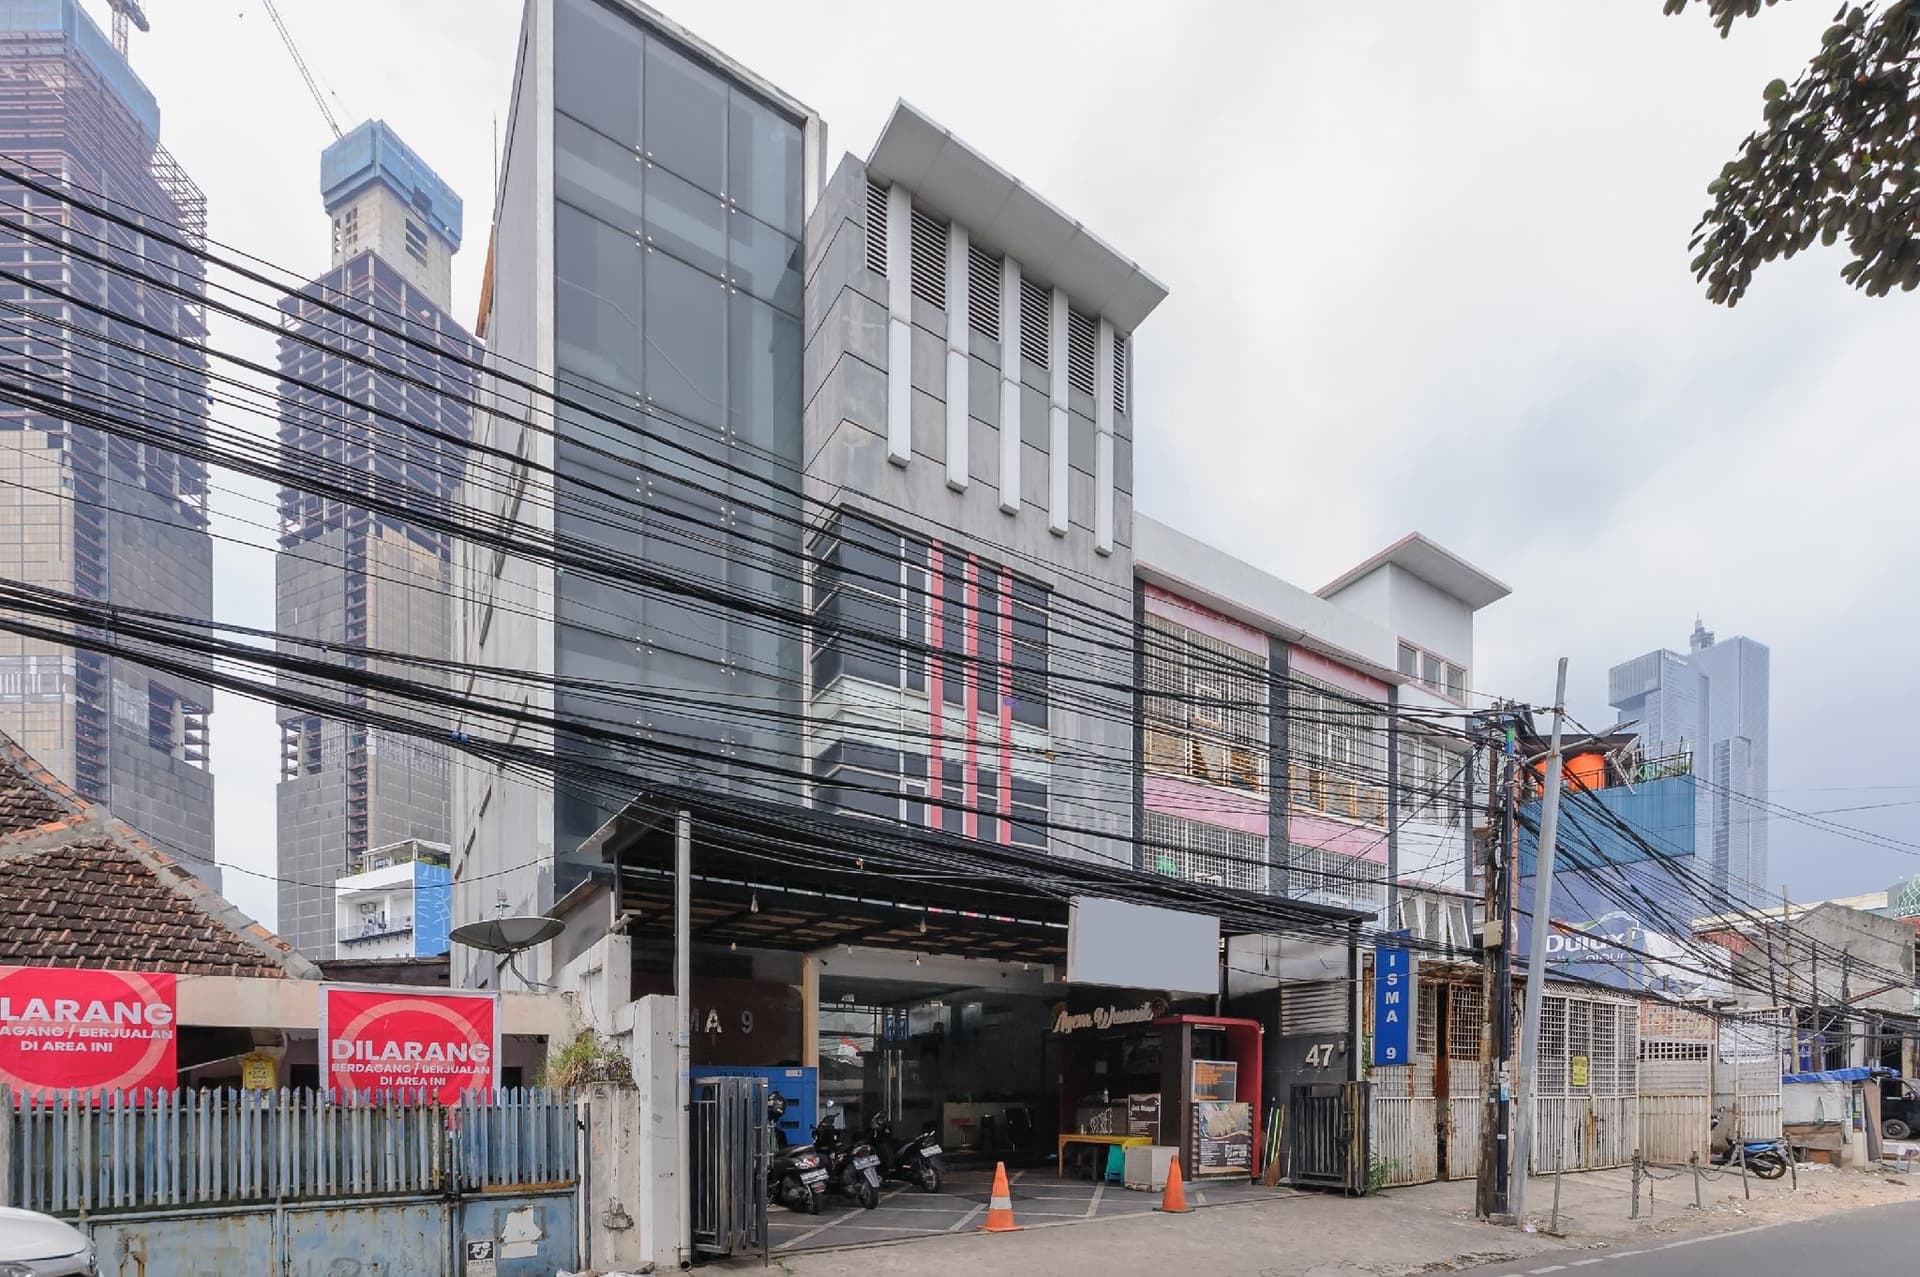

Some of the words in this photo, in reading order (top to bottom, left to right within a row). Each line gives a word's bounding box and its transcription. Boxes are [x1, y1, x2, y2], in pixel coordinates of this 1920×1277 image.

[1545, 933, 1625, 953] Dulux
[1385, 954, 1399, 1022] ISMA
[0, 997, 173, 1025] LARANG
[0, 1026, 64, 1037] AGANG
[67, 1025, 75, 1039] /
[79, 1028, 173, 1039] BERJUALAN
[741, 1010, 753, 1034] 9
[20, 1041, 38, 1051] DI
[42, 1041, 87, 1052] AREA
[91, 1042, 113, 1052] INI
[332, 1039, 490, 1062] DILARANG
[1305, 1044, 1334, 1067] 47
[1386, 1047, 1397, 1060] 9
[332, 1063, 411, 1074] BERDAGANG
[413, 1063, 419, 1075] /
[422, 1065, 490, 1075] BERJUALAN
[380, 1077, 393, 1086] DI
[395, 1077, 427, 1086] AREA
[430, 1077, 446, 1086] INI
